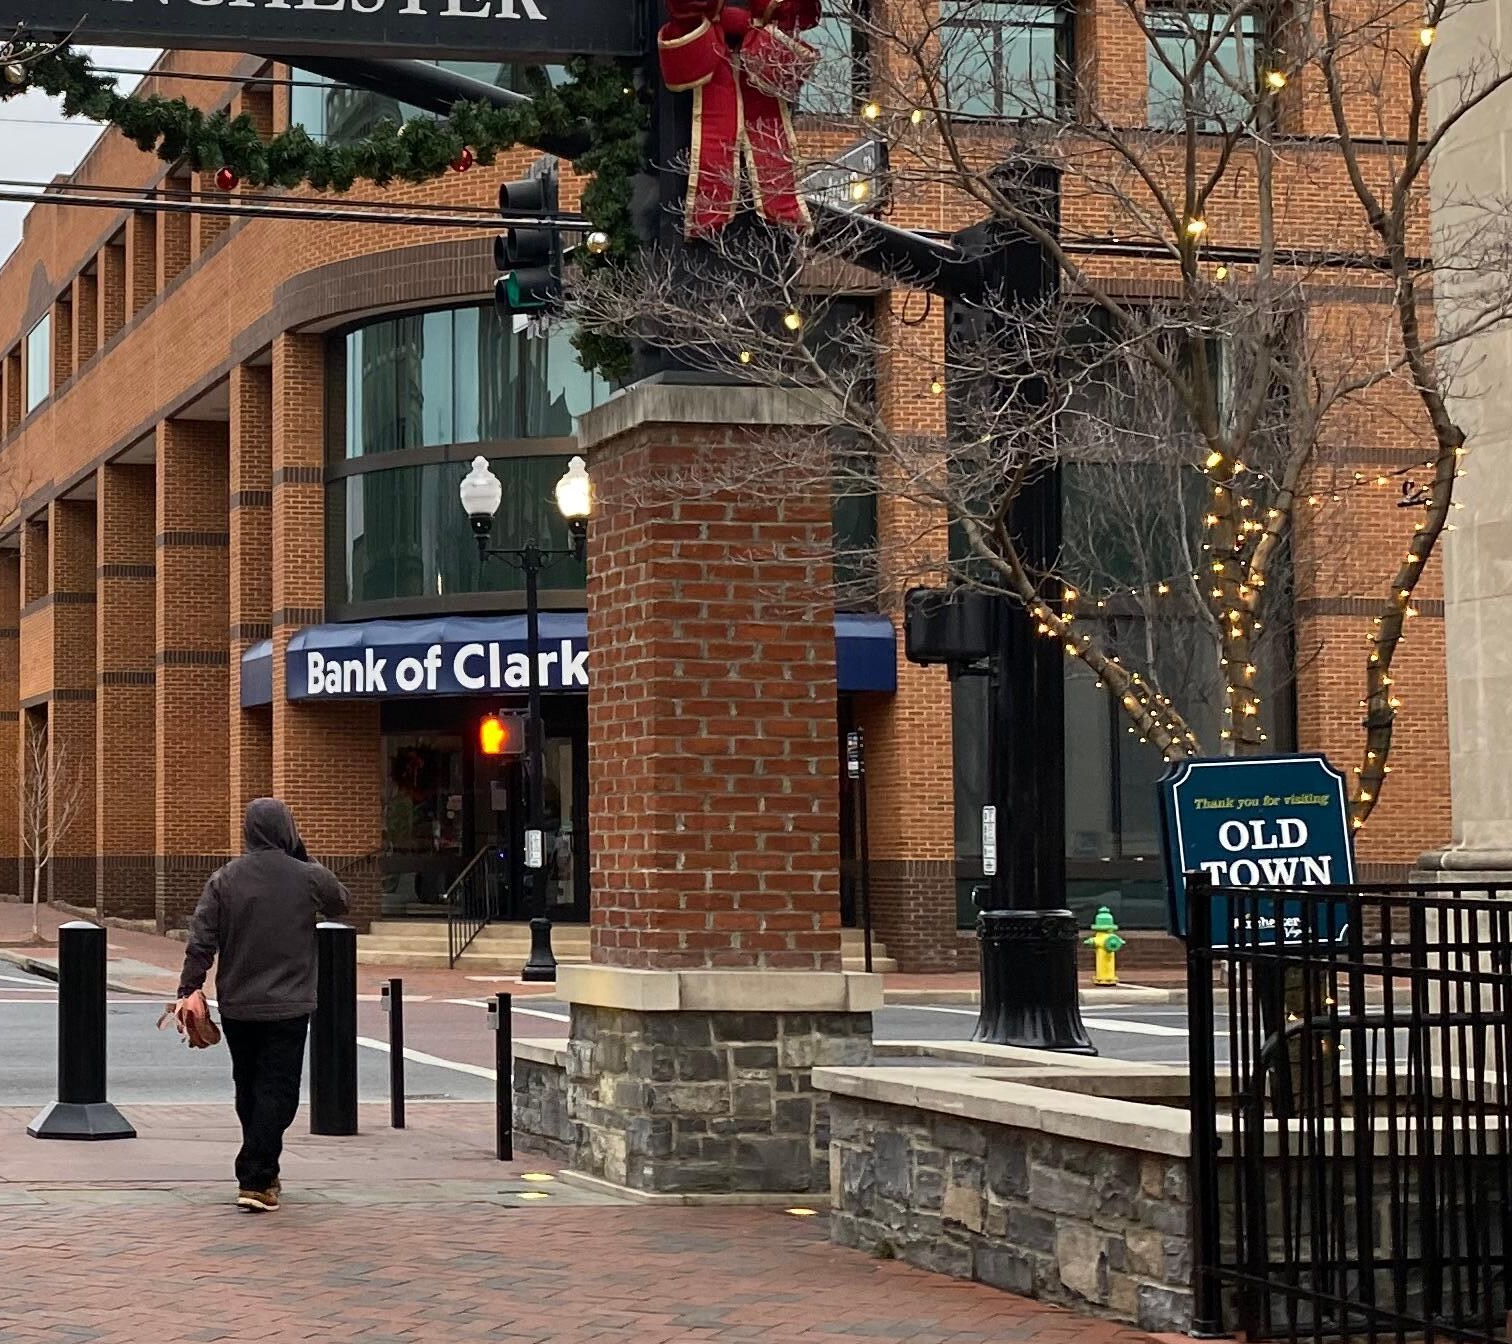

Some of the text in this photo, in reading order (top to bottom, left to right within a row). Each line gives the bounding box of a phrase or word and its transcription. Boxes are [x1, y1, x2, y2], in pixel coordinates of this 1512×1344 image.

[306, 639, 590, 695] Bank of Clark
[1193, 793, 1331, 810] Thank you for visiting
[1218, 818, 1308, 851] OLD
[1200, 856, 1332, 886] TOWN
